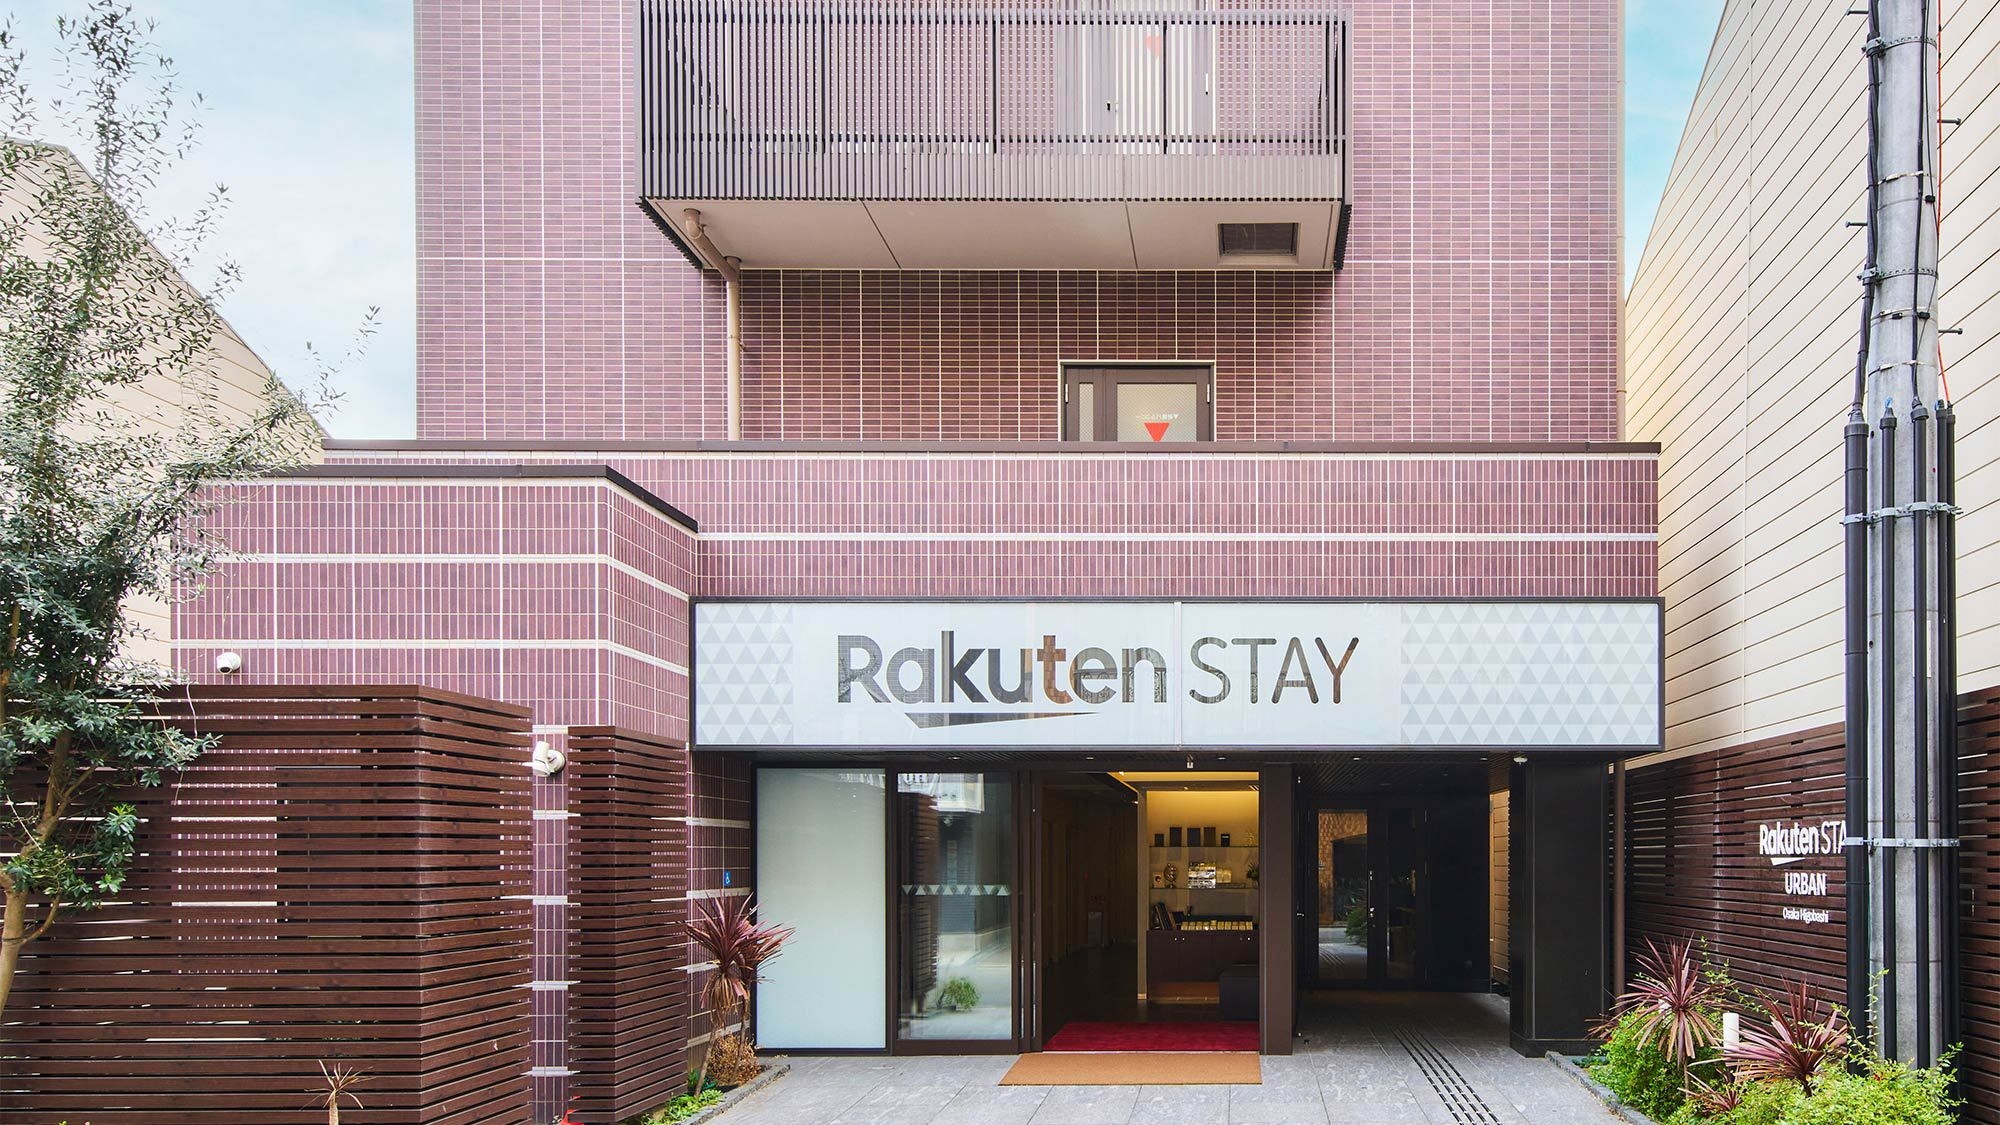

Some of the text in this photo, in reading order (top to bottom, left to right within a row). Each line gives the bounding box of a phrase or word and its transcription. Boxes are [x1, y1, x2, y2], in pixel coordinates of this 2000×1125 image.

[838, 630, 1360, 705] Rakuten STAY
[1759, 819, 1847, 855] Rakuten STA
[1784, 872, 1827, 896] URBAN
[1782, 907, 1800, 920] Osaka
